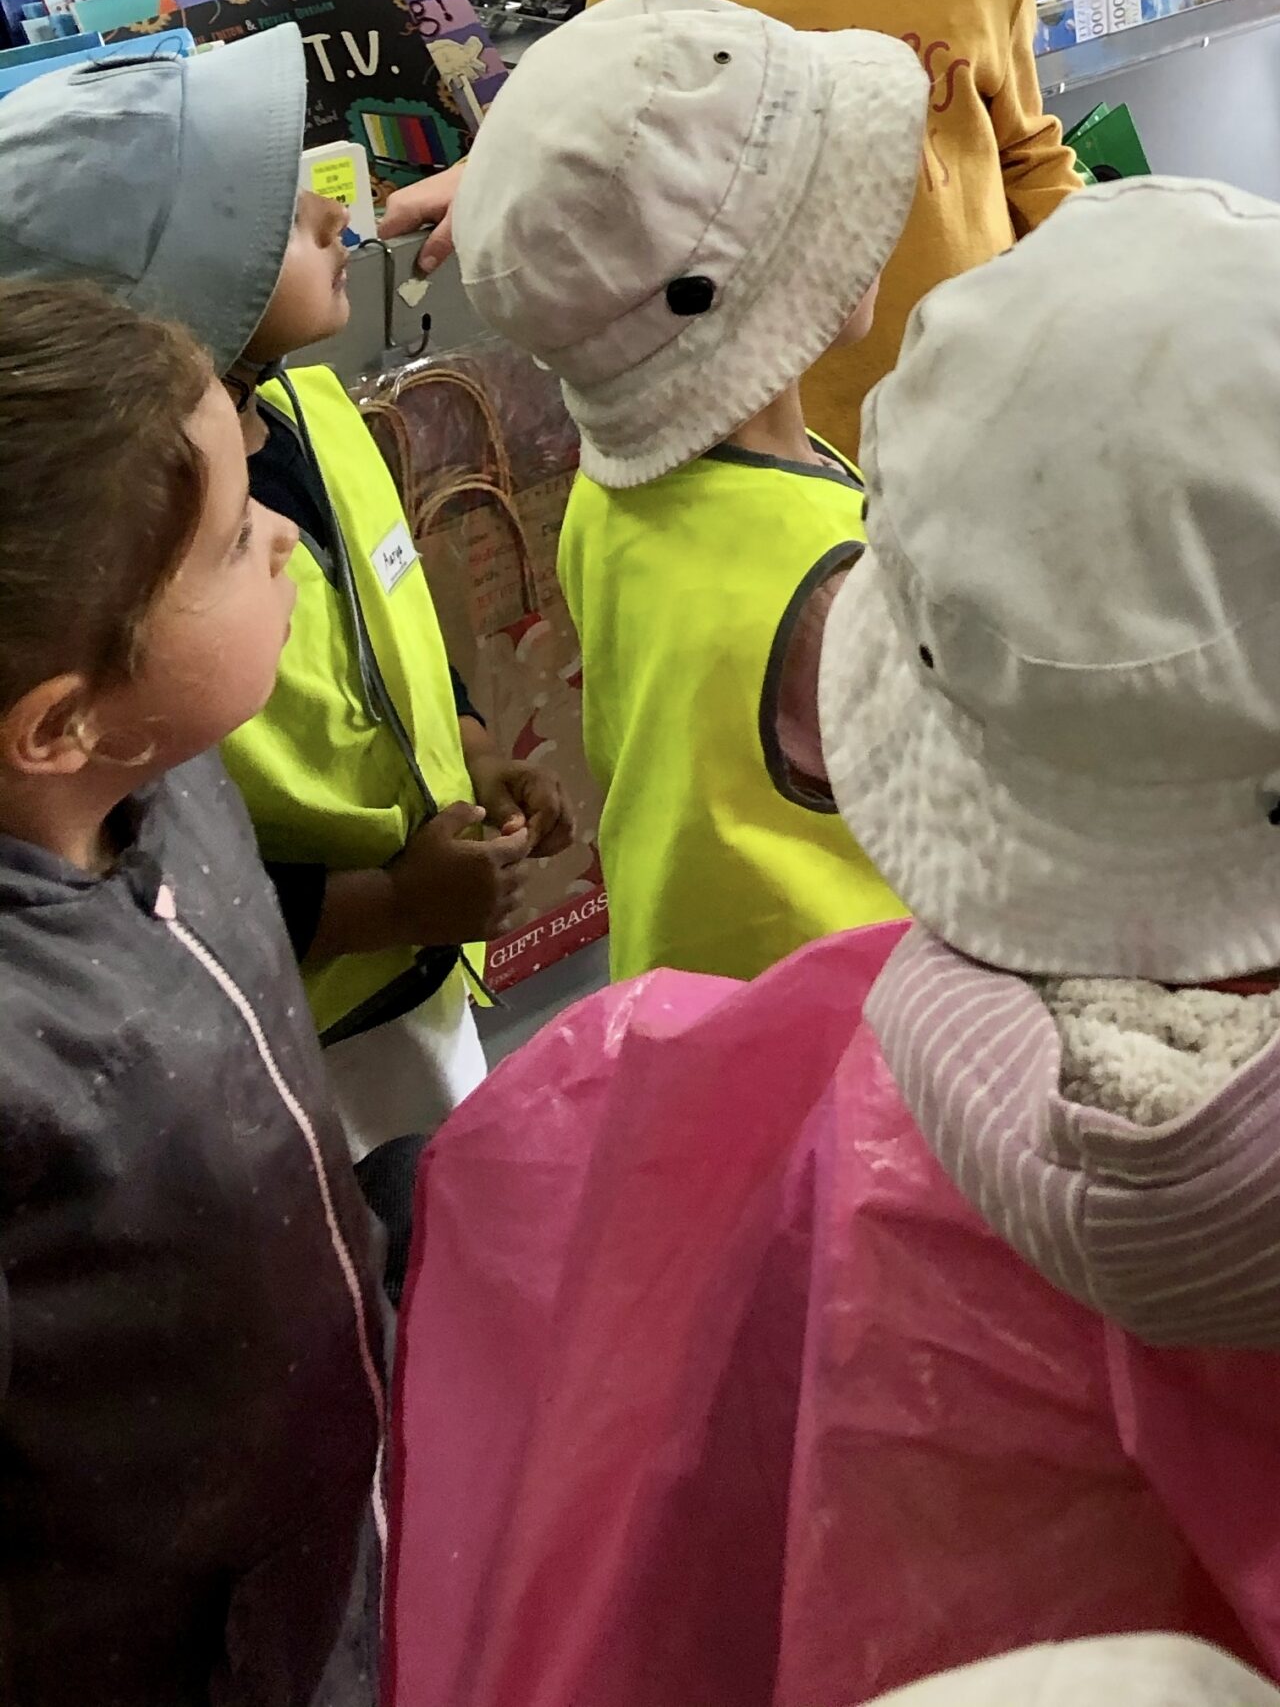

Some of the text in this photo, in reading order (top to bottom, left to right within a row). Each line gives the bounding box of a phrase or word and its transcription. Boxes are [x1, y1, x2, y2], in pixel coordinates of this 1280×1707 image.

[245, 19, 257, 31] &
[489, 891, 609, 968] GIFT BAGS
